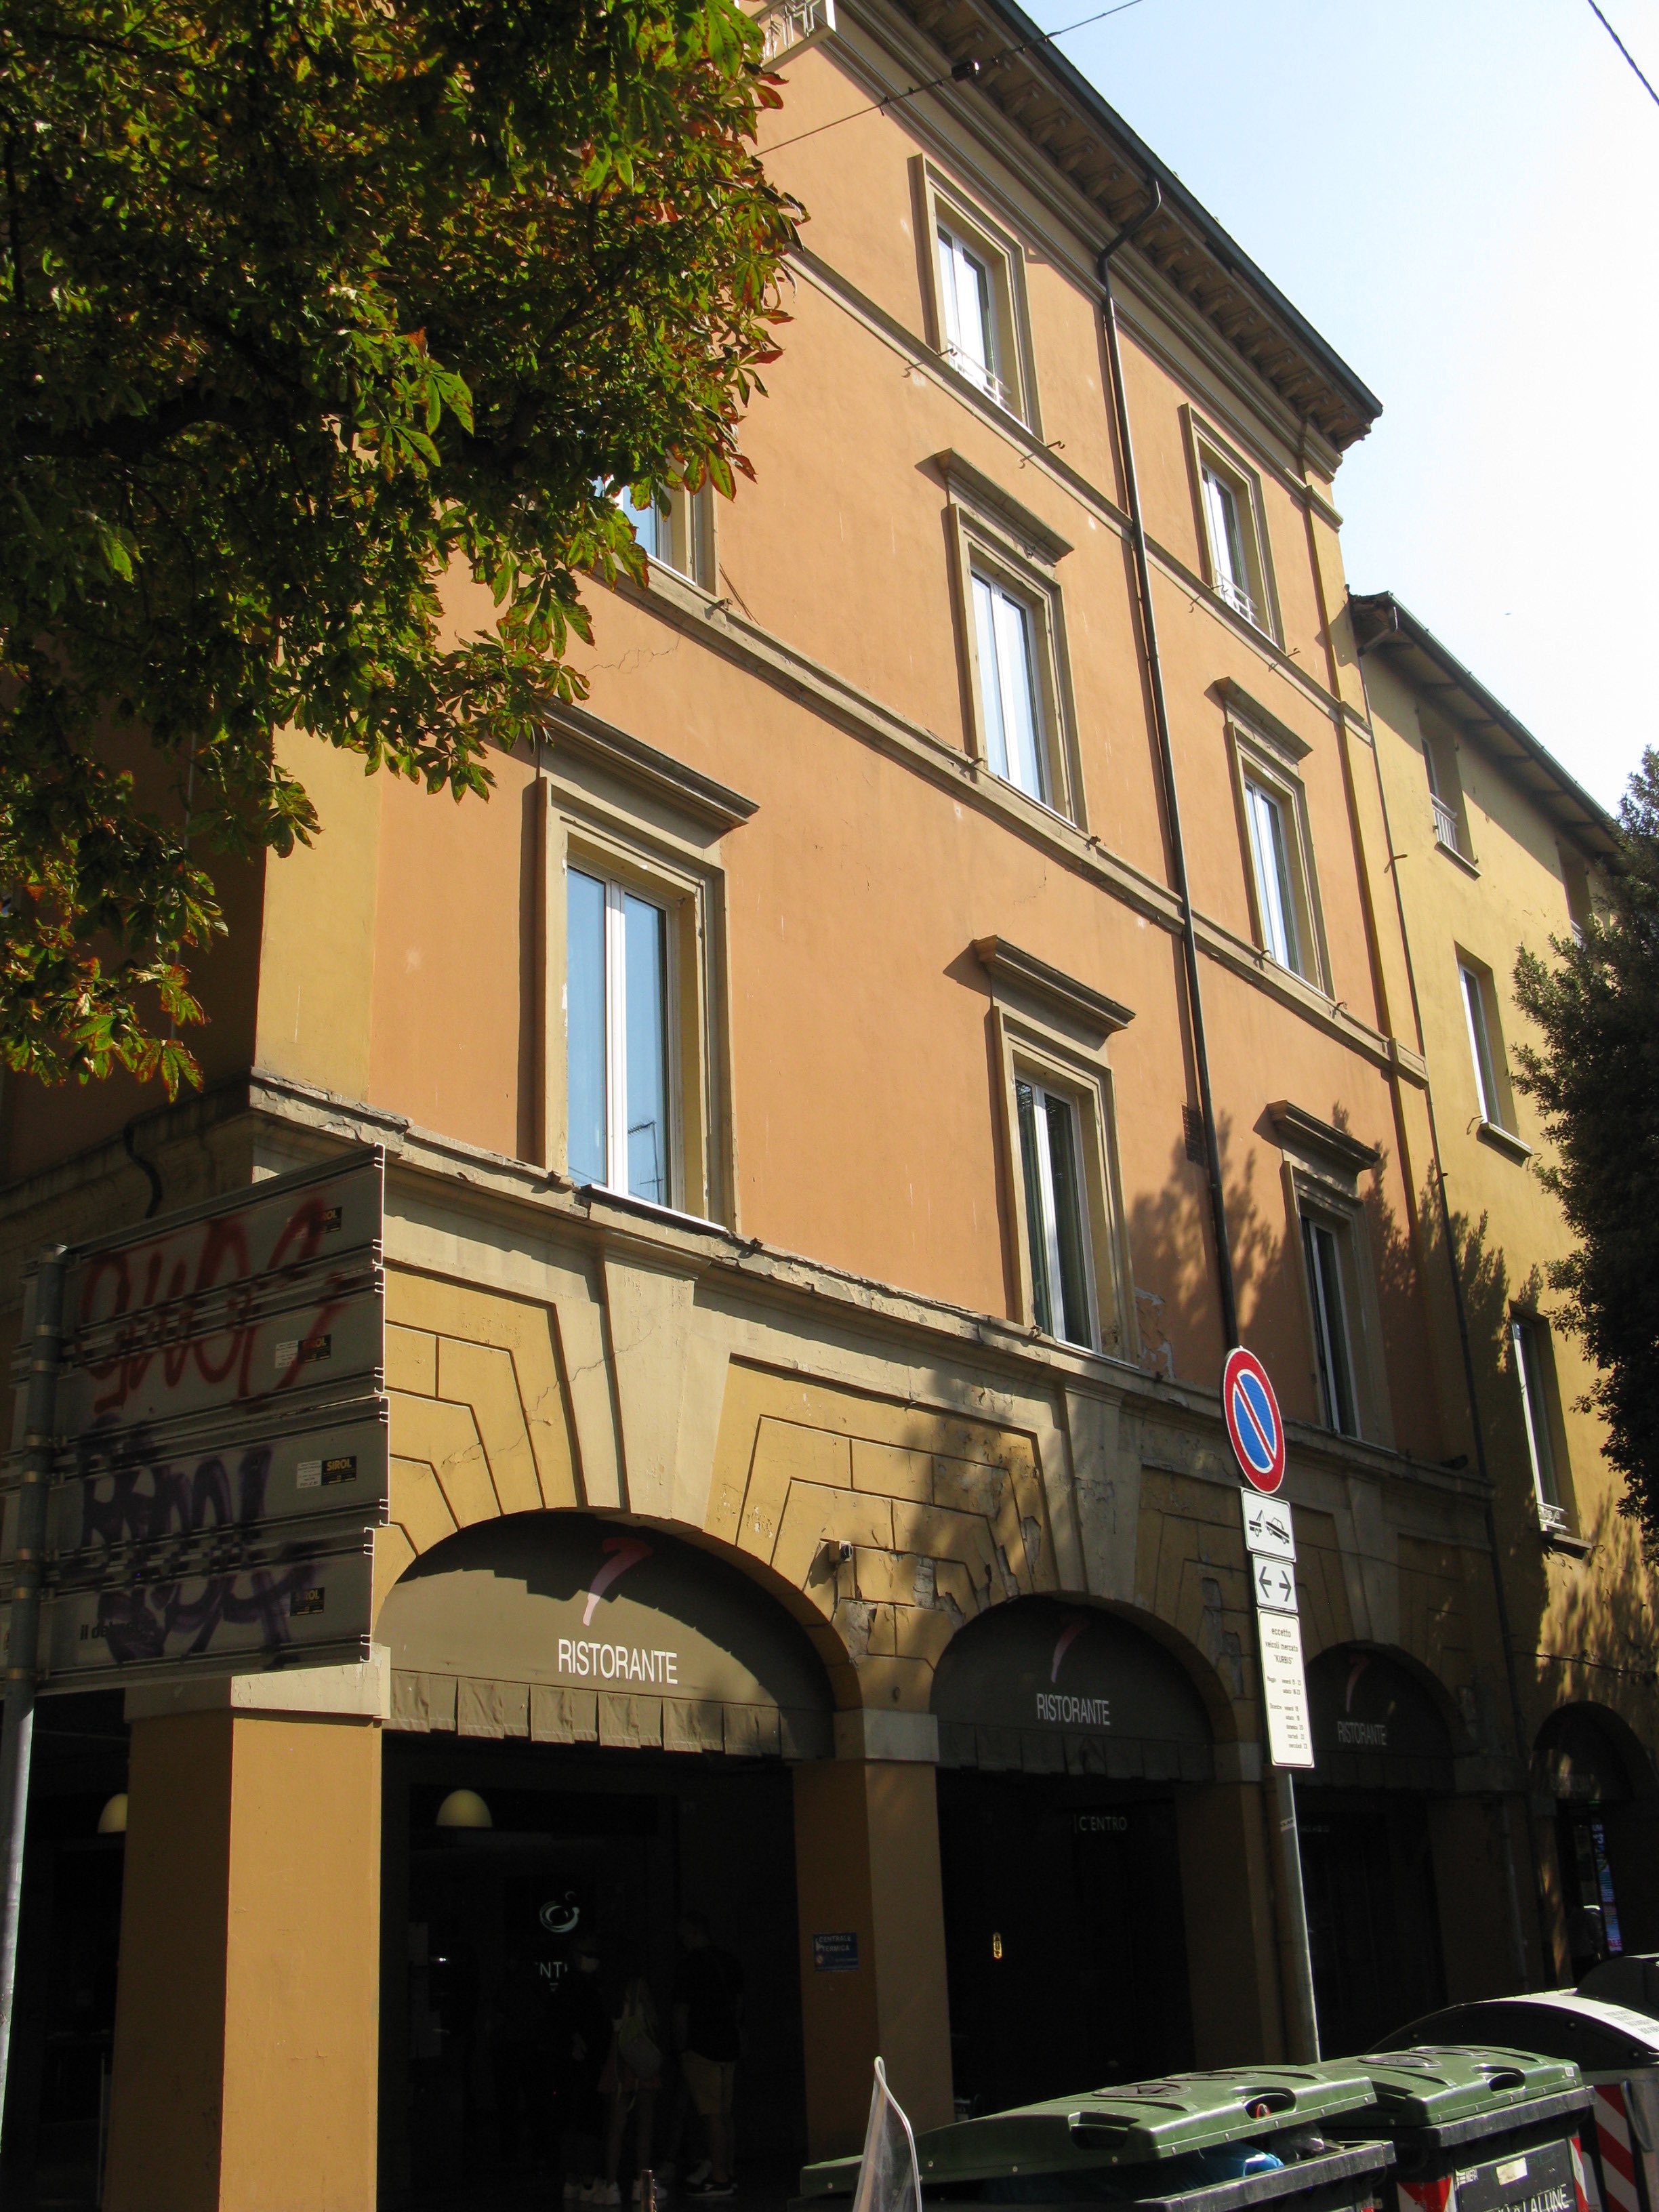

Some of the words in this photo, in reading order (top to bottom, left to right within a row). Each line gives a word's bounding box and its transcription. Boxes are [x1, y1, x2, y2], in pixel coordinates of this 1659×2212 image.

[326, 1458, 352, 1471] SIROL
[1271, 1627, 1292, 1637] eccetto
[1265, 1641, 1279, 1650] veicoli
[1280, 1644, 1298, 1652] mercato
[558, 1638, 678, 1684] RISTORANTE
[1036, 1693, 1111, 1726] RISTORANTE
[1337, 1721, 1387, 1746] RISTORANTE
[822, 1944, 850, 1952] TERMICA
